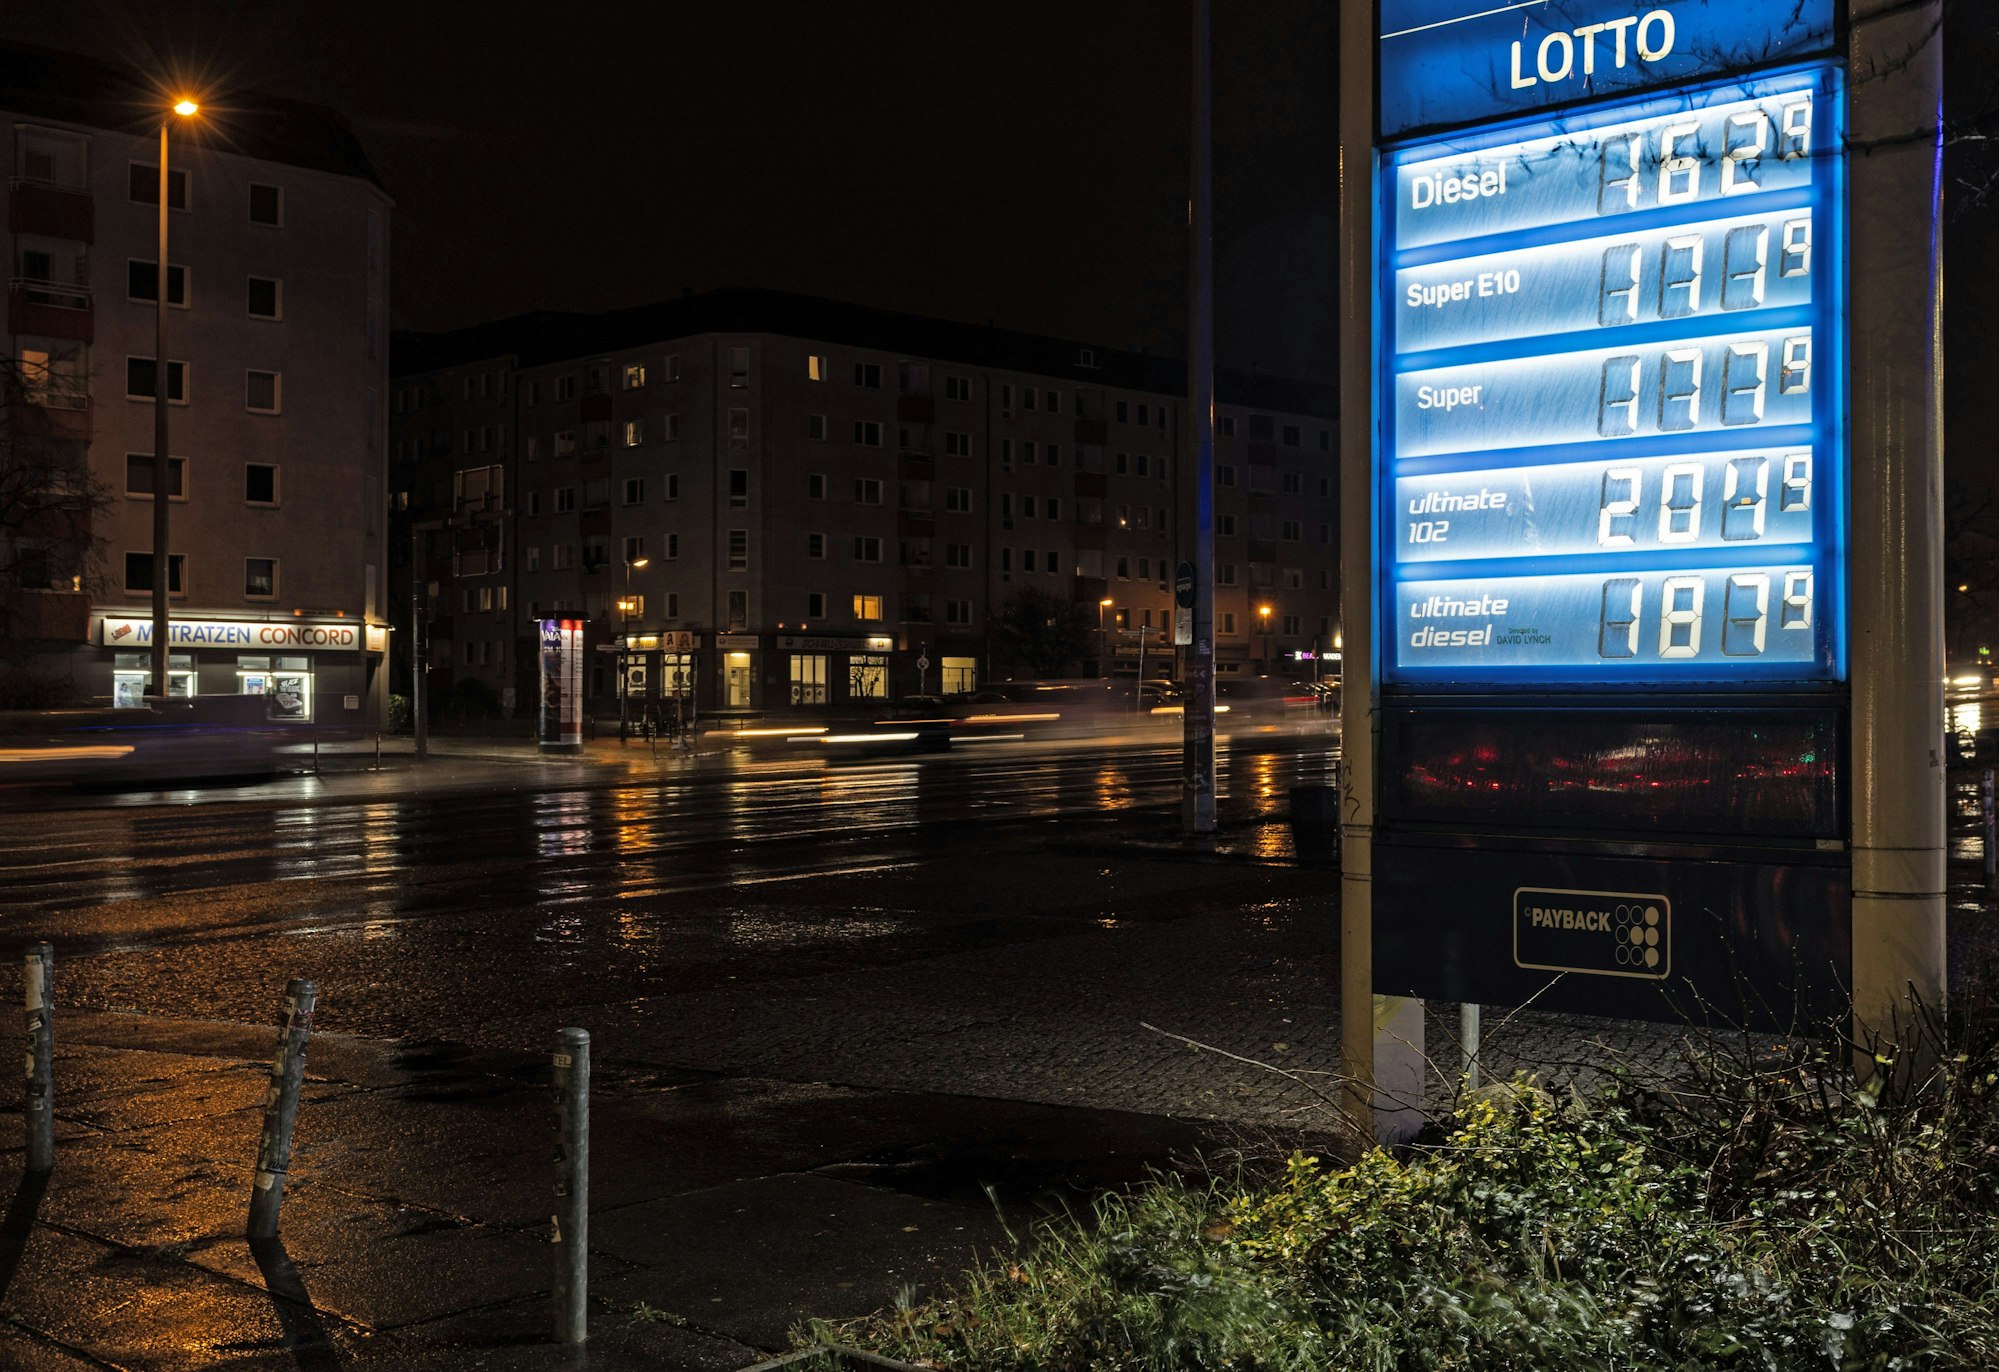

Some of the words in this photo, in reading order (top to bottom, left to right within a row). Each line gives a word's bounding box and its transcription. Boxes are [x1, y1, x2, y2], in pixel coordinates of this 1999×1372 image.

[1511, 9, 1675, 90] LOTTO
[1411, 160, 1506, 210] Diesel
[1406, 280, 1474, 308] Super
[1478, 269, 1520, 297] E10
[1417, 384, 1483, 411] Super
[1408, 487, 1508, 515] ultimate
[1408, 520, 1450, 544] 102
[1410, 593, 1509, 618] ultimate
[136, 624, 251, 645] MTRATZEN
[259, 626, 354, 647] CONCORD
[1410, 623, 1493, 648] diesel
[1497, 635, 1522, 645] DAVID
[1524, 634, 1551, 645] LYNCH
[1532, 907, 1612, 932] PAYBACK
